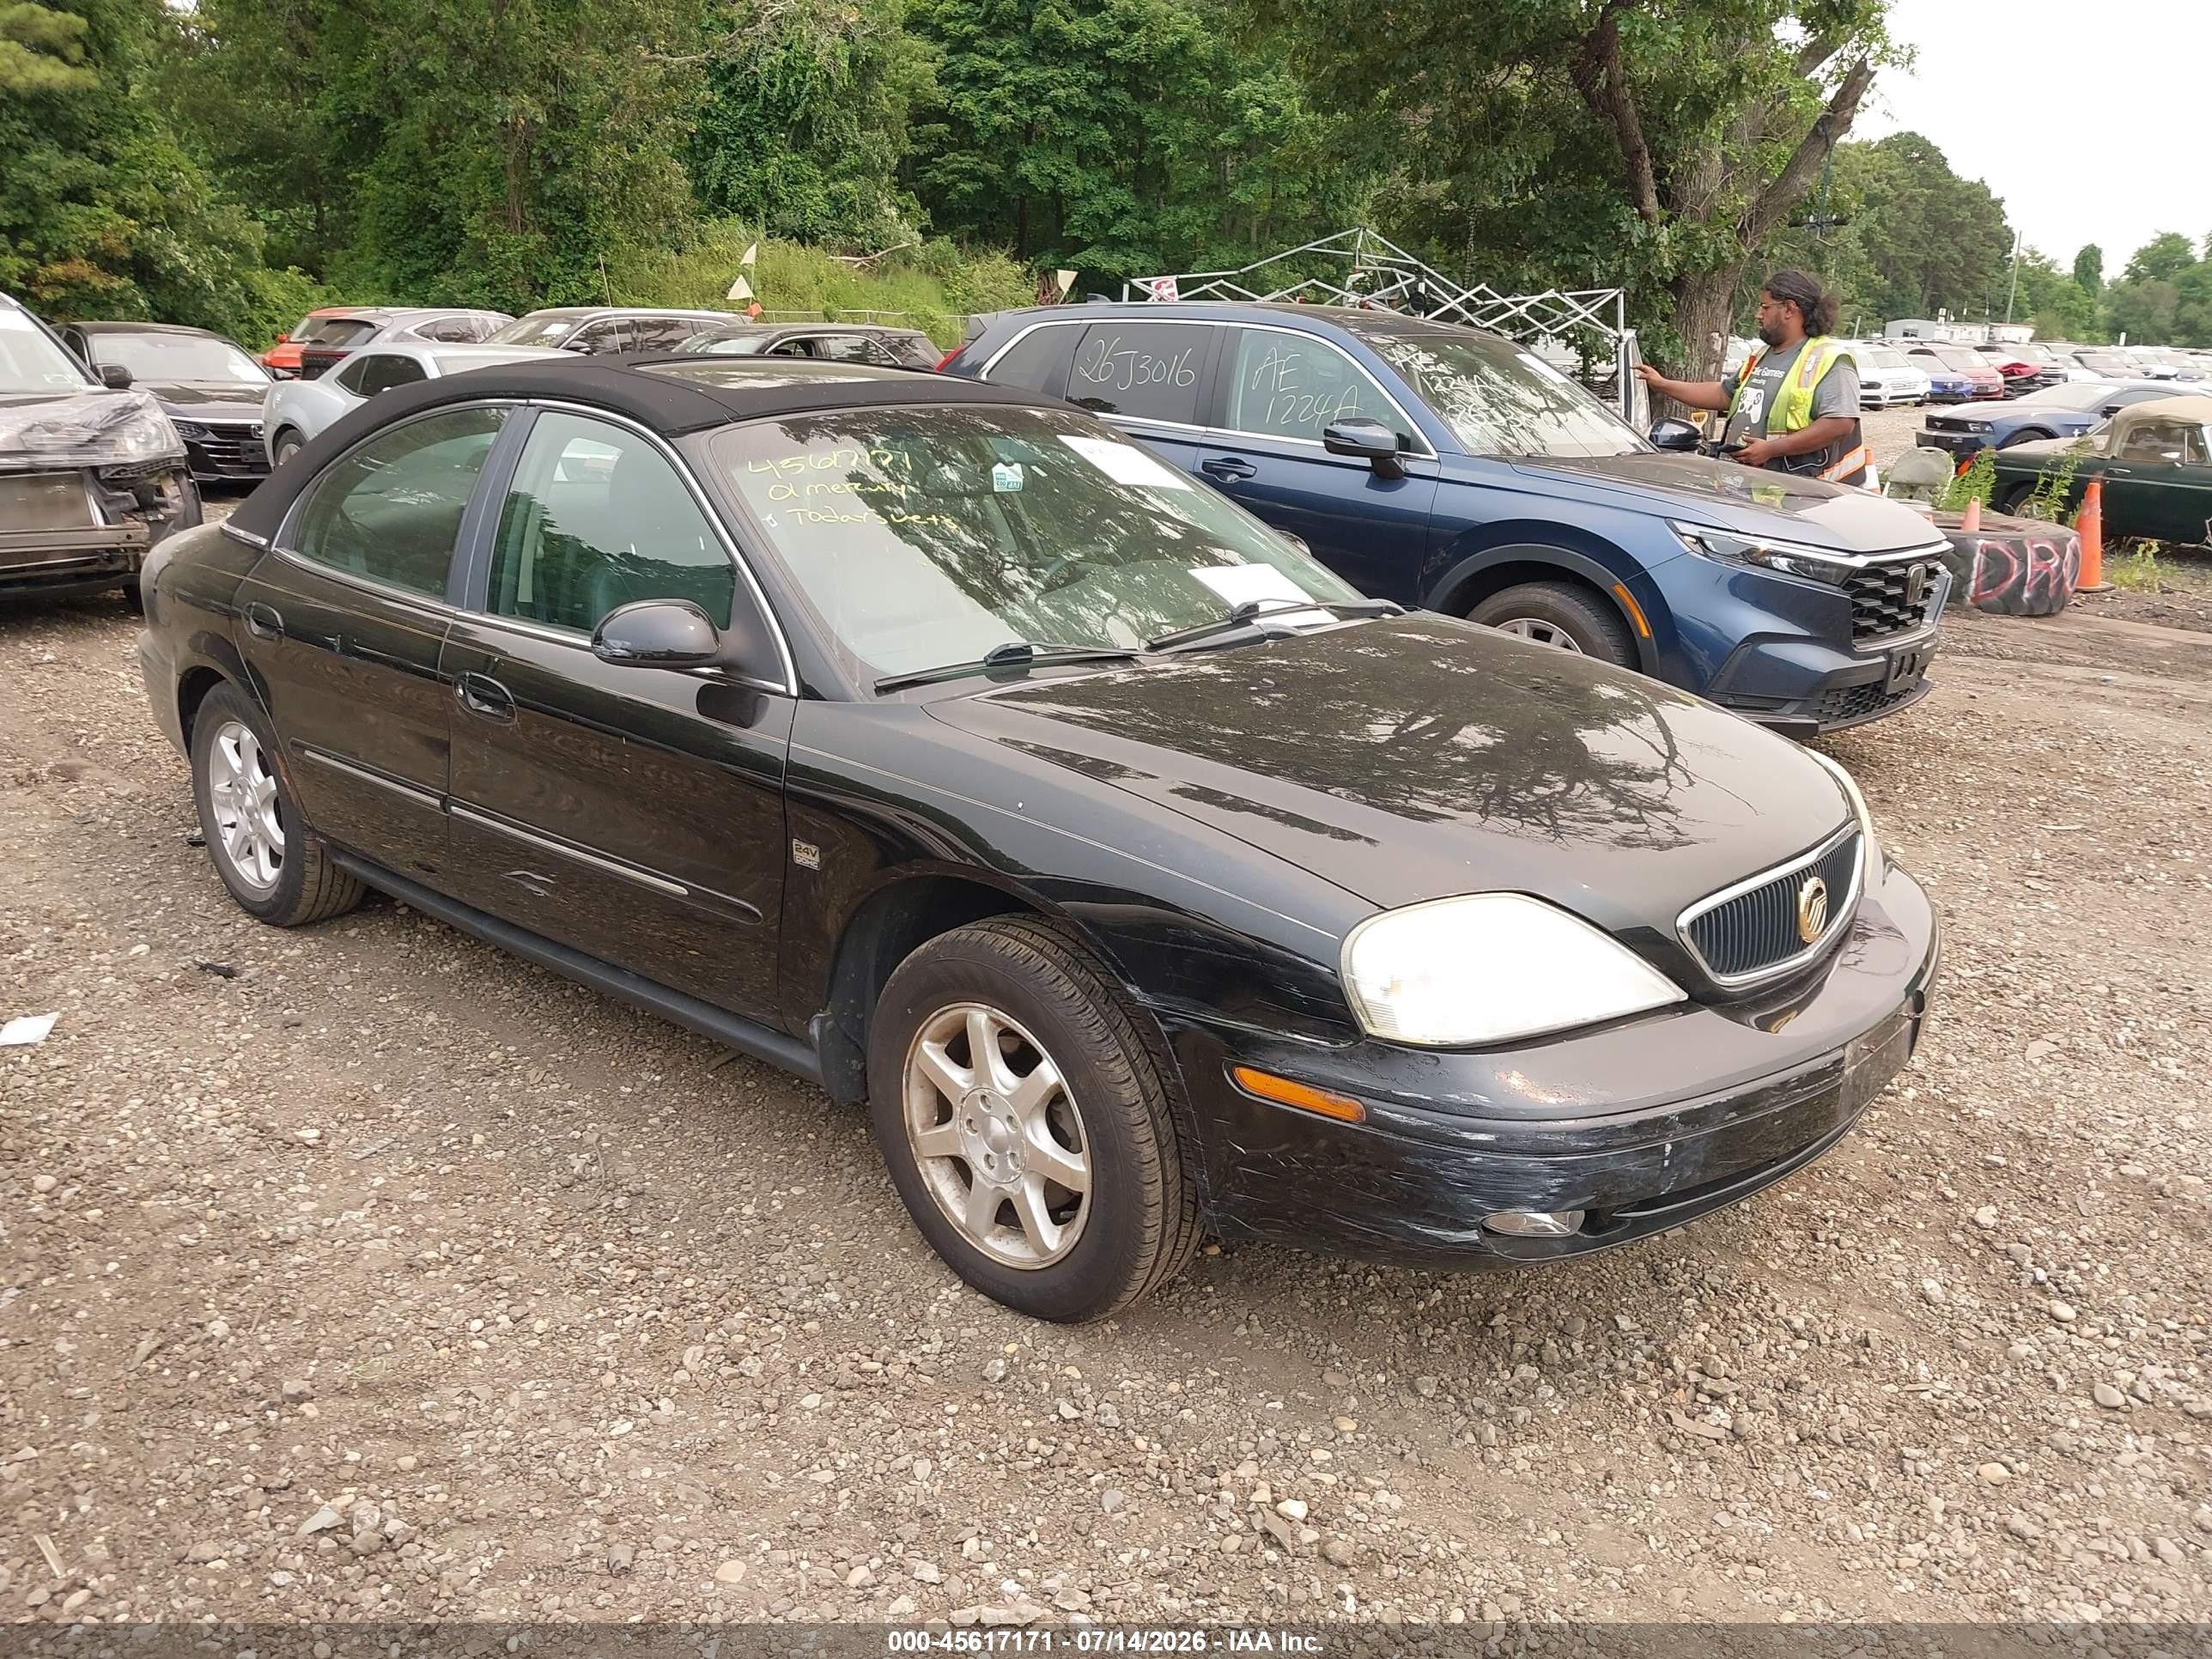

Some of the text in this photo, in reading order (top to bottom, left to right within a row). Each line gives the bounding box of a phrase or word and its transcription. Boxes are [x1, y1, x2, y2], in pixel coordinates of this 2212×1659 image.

[1079, 337, 1196, 391] 26J3016
[1251, 345, 1302, 392] AE
[1265, 385, 1365, 428] 1224A
[795, 843, 818, 857] 24V
